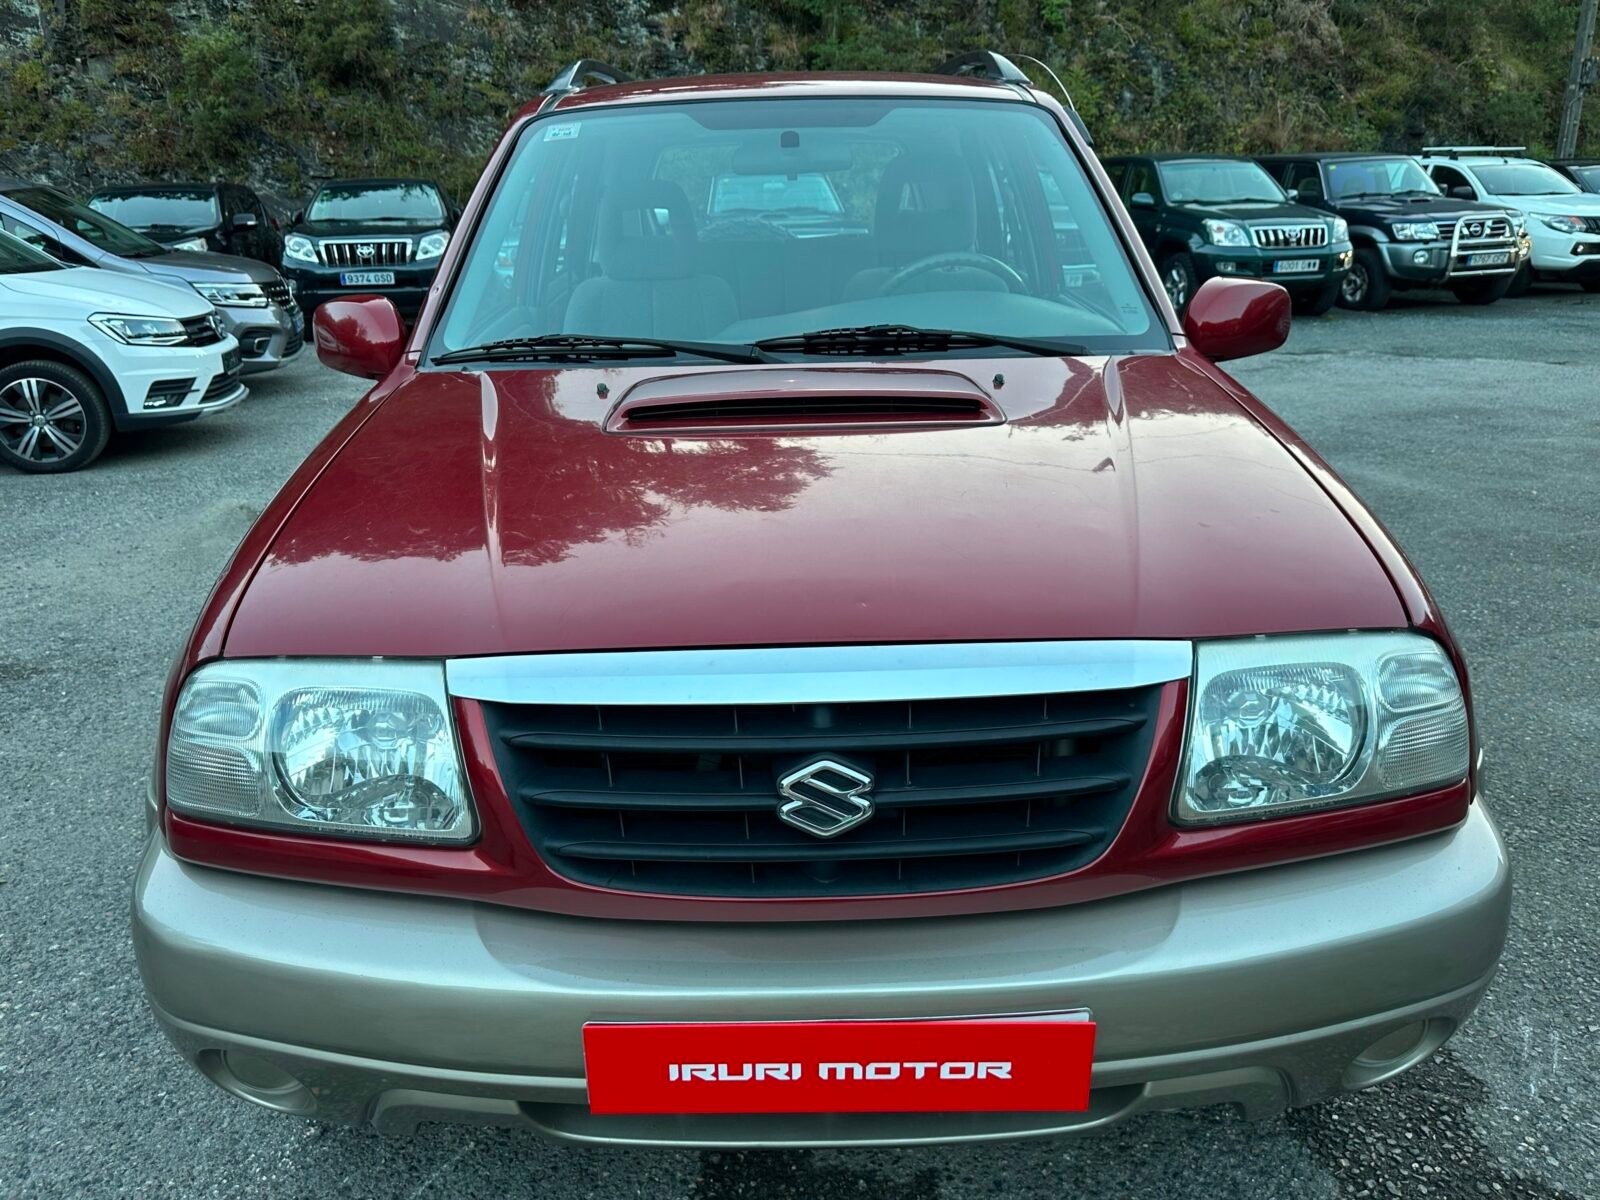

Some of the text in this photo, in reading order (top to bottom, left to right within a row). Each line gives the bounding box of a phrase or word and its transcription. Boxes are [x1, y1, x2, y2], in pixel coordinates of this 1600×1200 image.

[347, 274, 371, 283] 9374
[668, 1061, 1012, 1082] IRURI MOTOR
